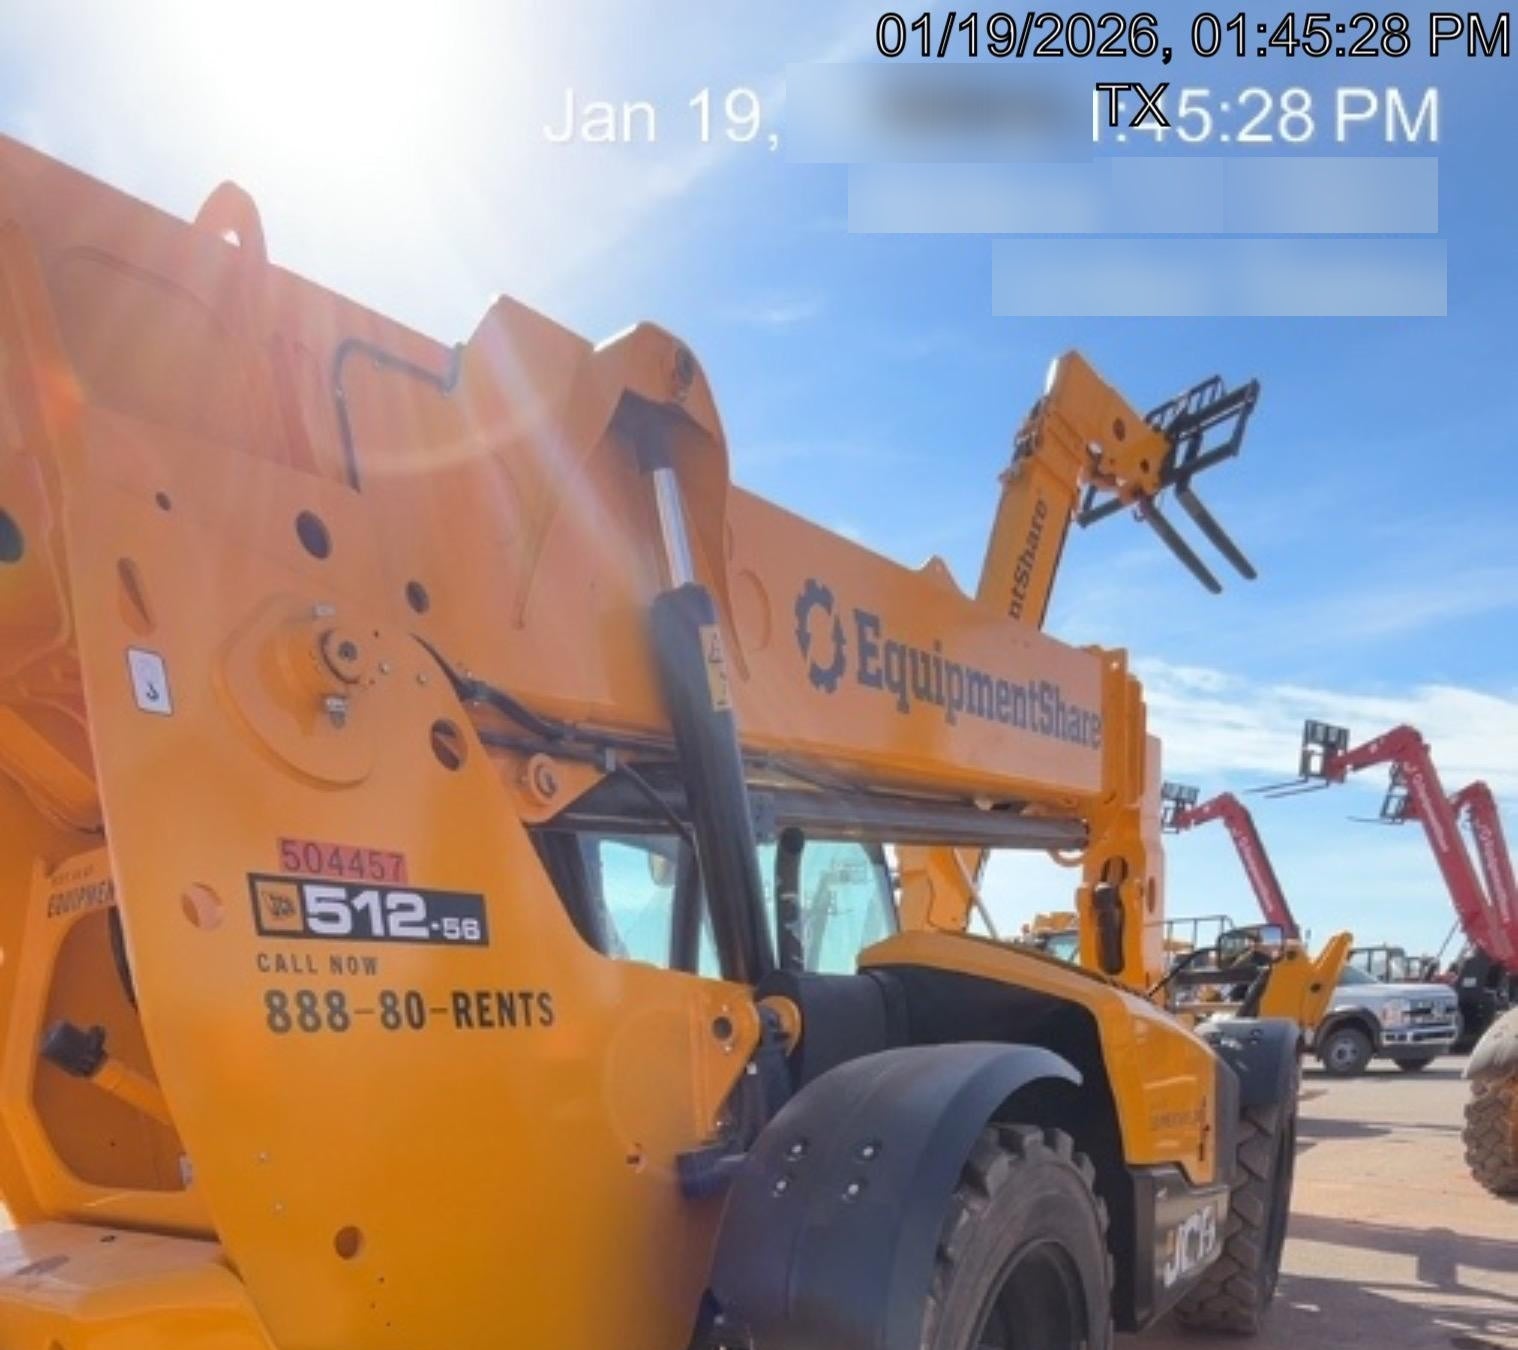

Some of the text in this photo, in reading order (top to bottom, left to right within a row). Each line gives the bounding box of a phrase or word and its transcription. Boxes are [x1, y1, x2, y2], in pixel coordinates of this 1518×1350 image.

[853, 607, 1102, 750] EquipmentShare
[280, 839, 405, 883] 504457
[255, 952, 378, 977] CALL NOW
[263, 989, 555, 1034] 888-80-RENTS
